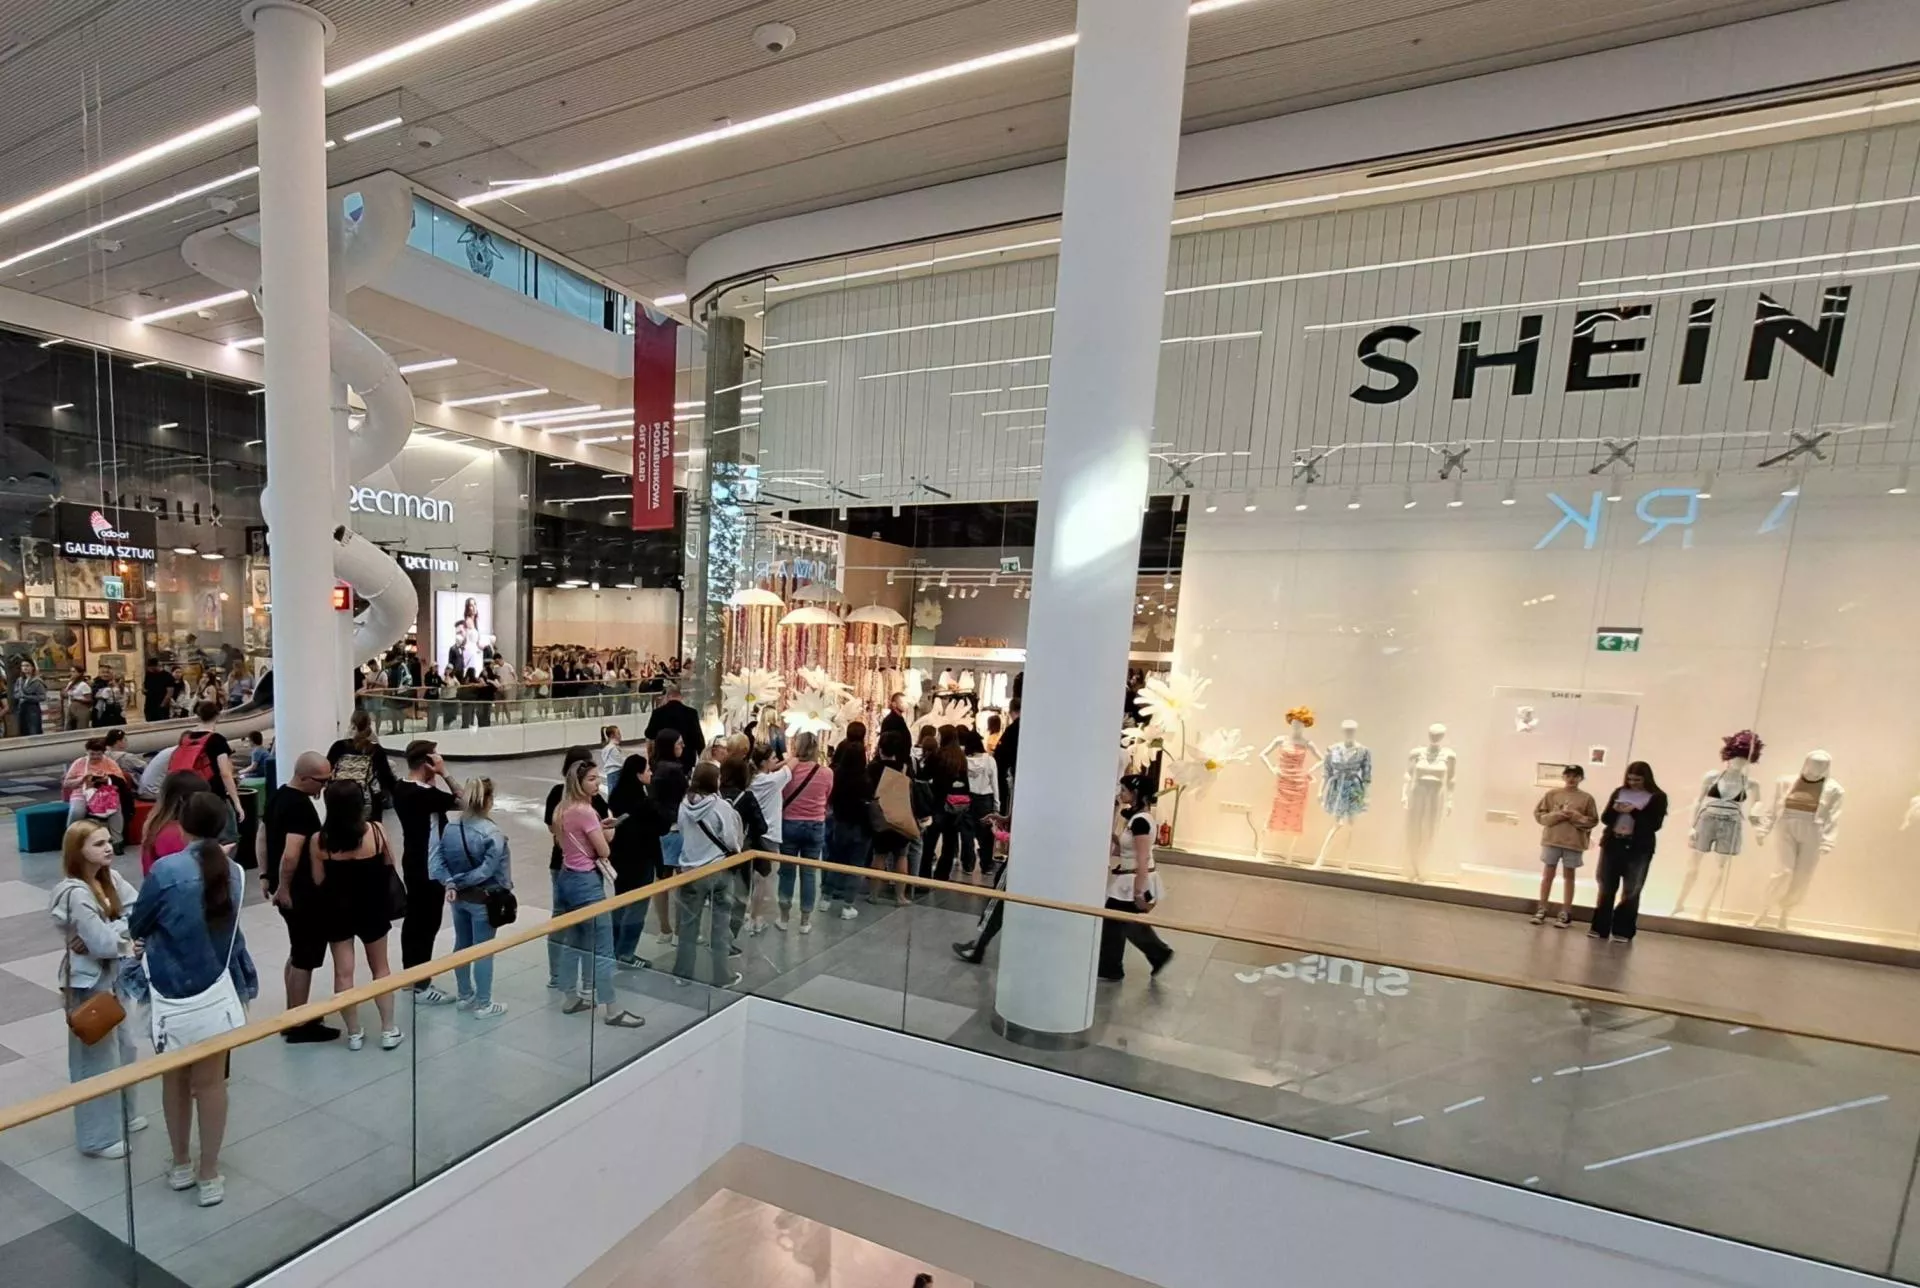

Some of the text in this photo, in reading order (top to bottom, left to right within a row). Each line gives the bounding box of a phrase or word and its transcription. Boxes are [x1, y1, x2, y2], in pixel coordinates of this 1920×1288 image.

[1349, 285, 1853, 405] SHEIN
[661, 421, 670, 458] KARTA
[638, 451, 646, 482] CARD
[65, 542, 155, 560] GALERIA SZTUKI
